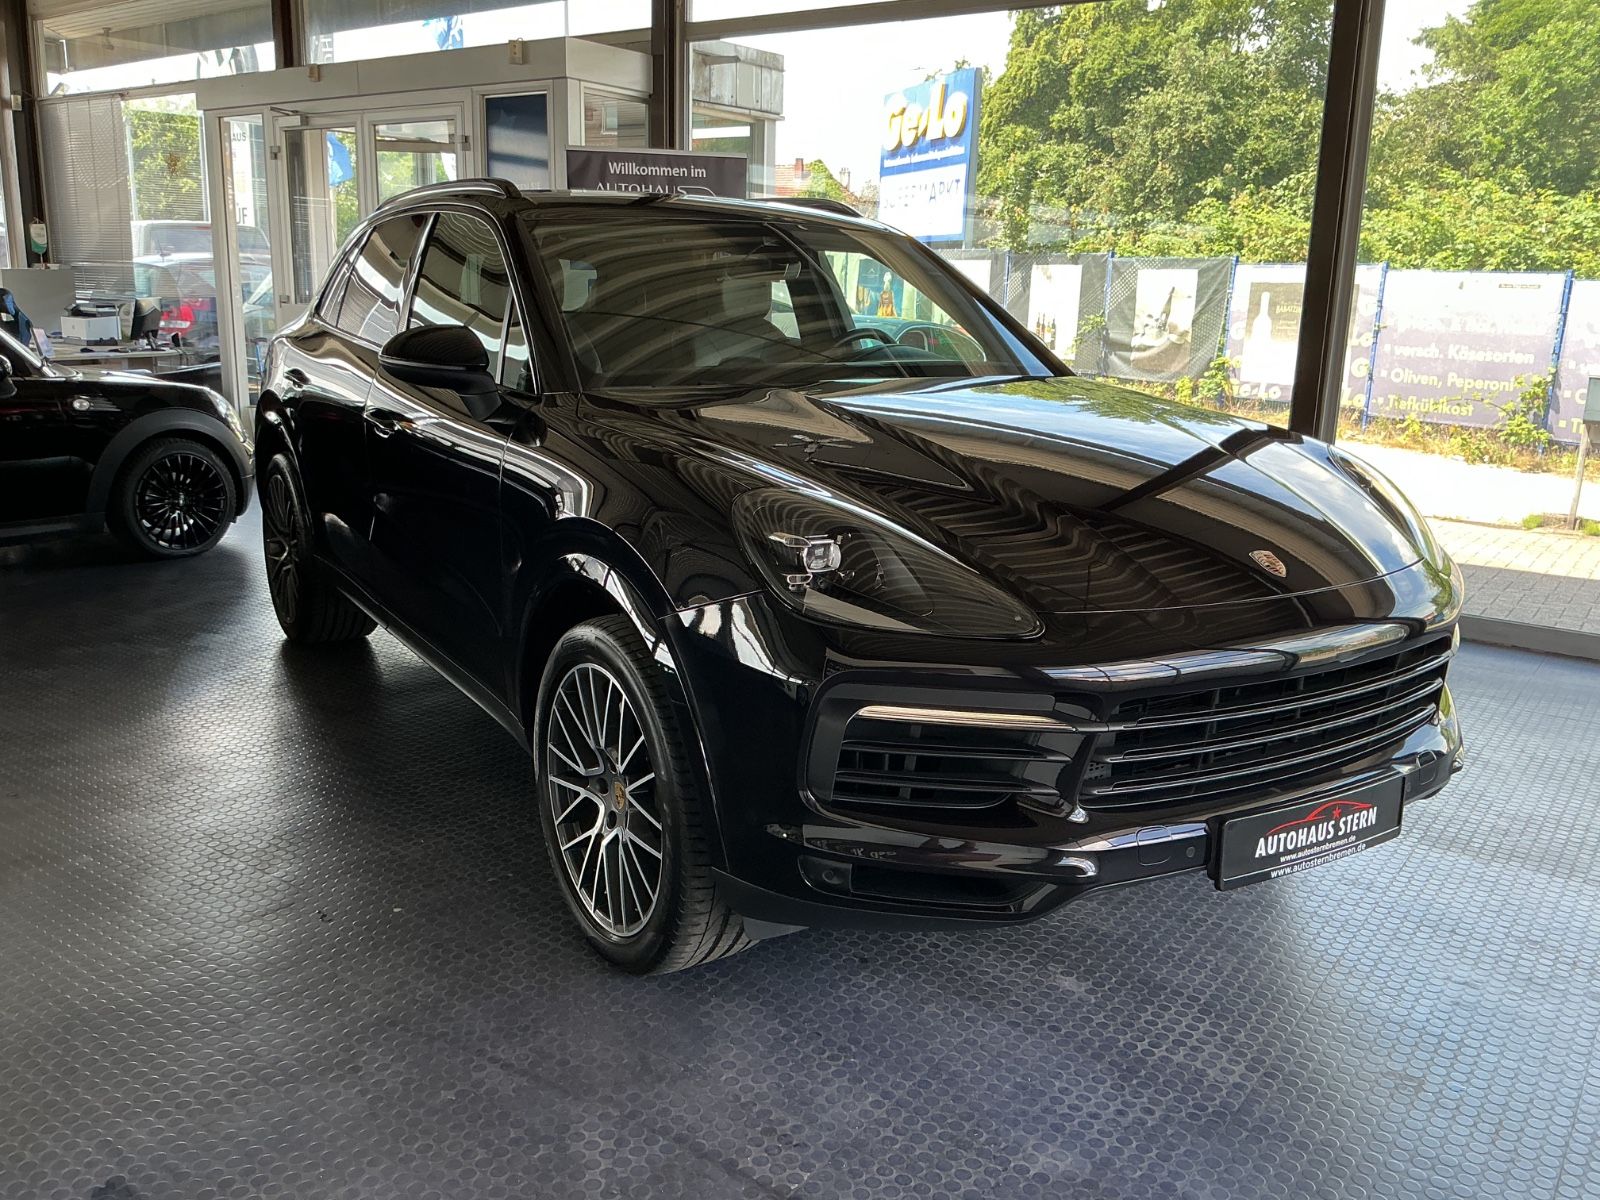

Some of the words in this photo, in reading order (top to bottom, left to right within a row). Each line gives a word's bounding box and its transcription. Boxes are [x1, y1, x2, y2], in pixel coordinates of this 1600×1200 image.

[608, 161, 688, 177] Willkommen
[691, 166, 706, 178] im
[1390, 368, 1442, 389] Oliven,
[1447, 371, 1514, 393] Peperoni
[1255, 820, 1335, 858] AUTOHAUS
[1338, 806, 1377, 836] STERN
[1270, 842, 1366, 878] www.autosternbremen.de
[1280, 835, 1356, 863] www.autosternbremen.de
